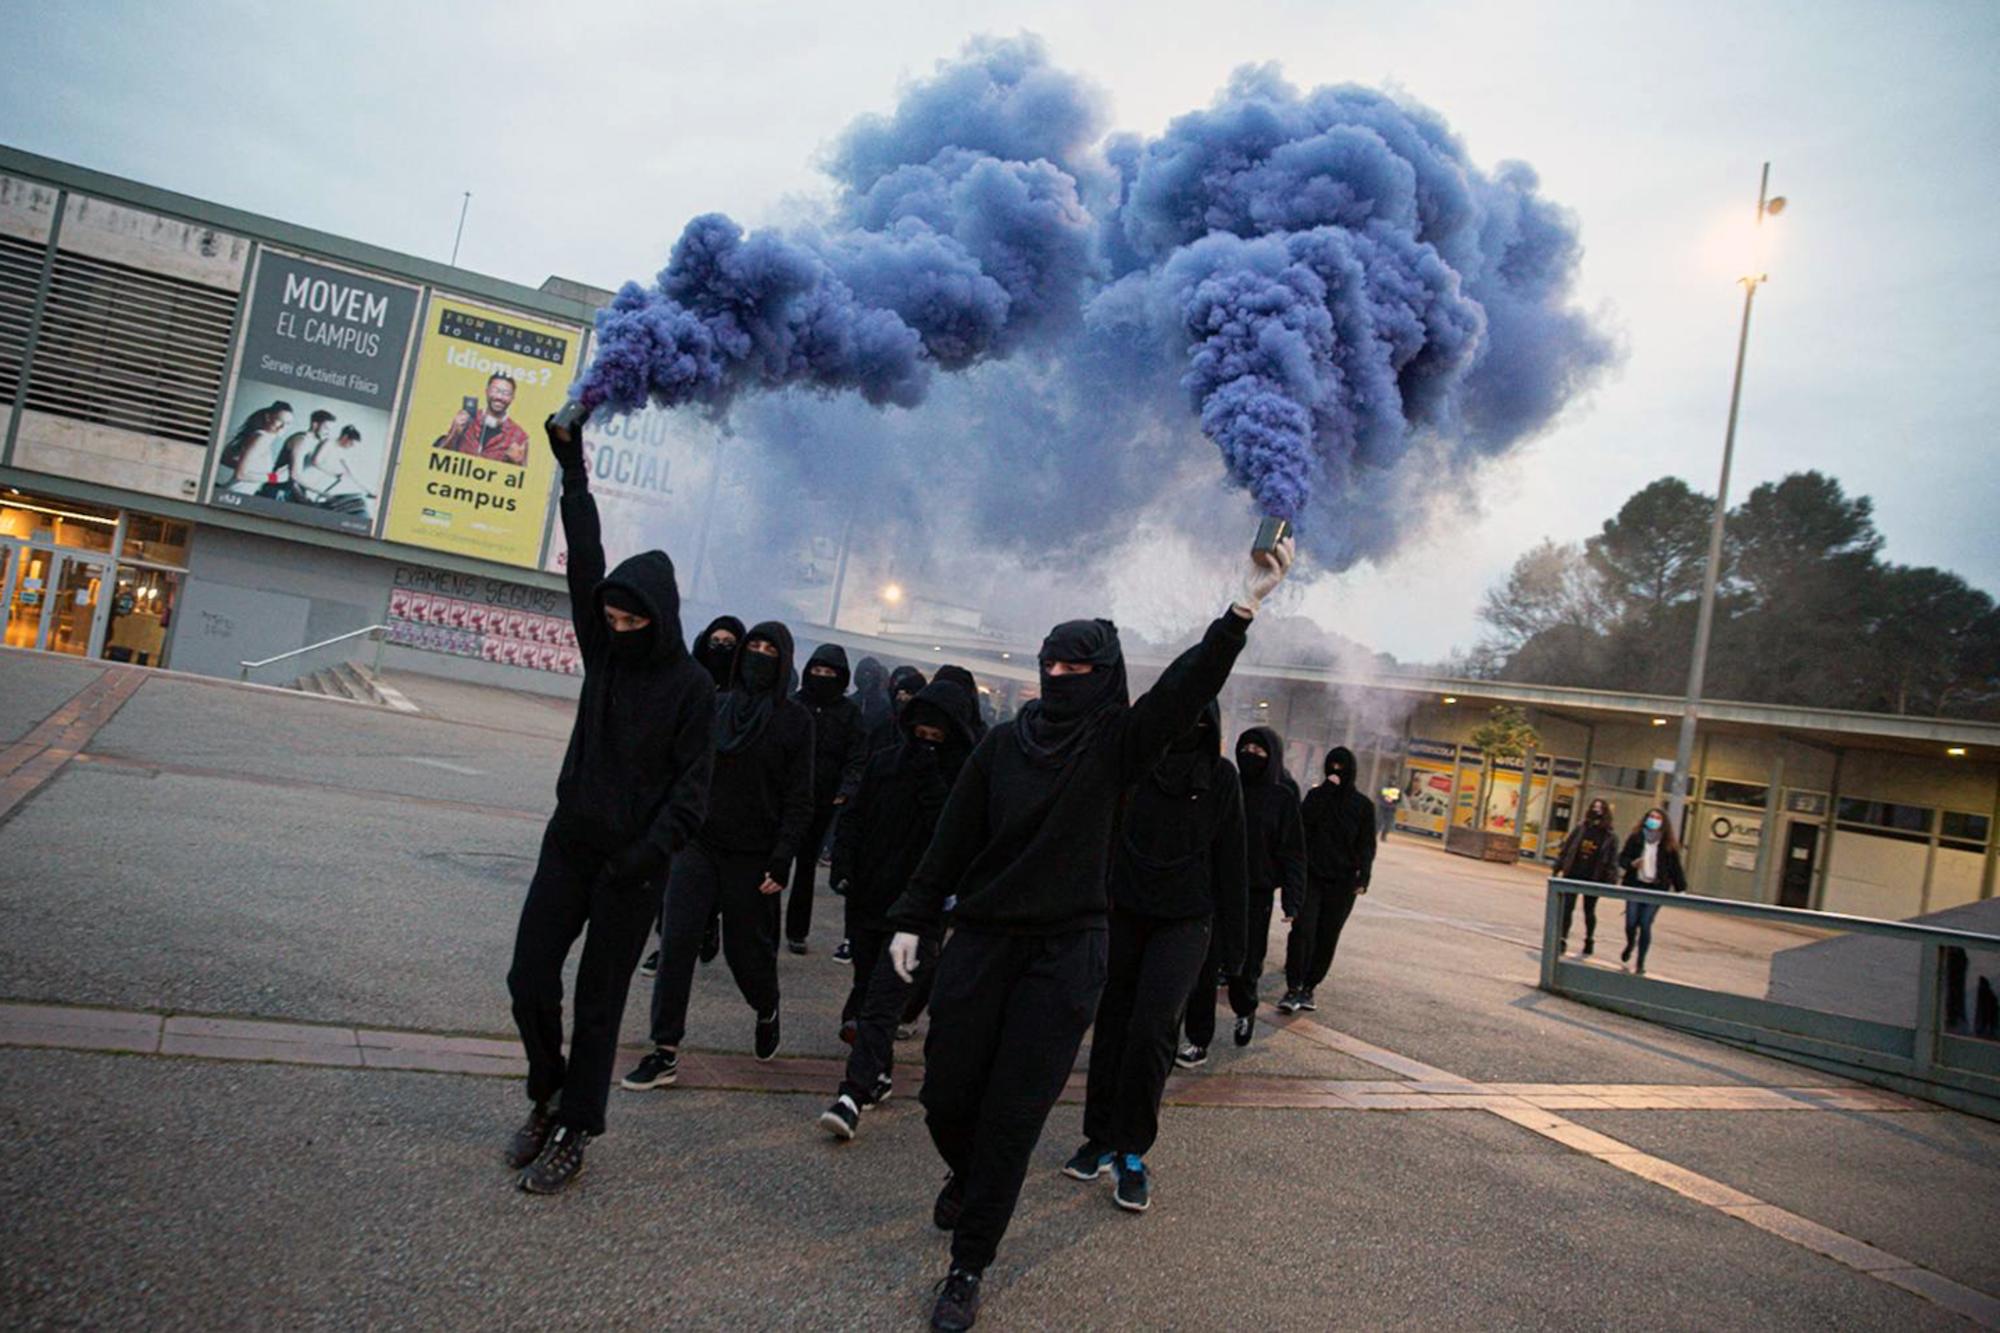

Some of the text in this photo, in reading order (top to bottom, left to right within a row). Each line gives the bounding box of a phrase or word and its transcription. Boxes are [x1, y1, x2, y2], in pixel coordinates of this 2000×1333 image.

[283, 273, 388, 327] MOVEM
[276, 311, 380, 357] EL CAMPUS
[443, 325, 462, 337] TO
[447, 346, 552, 387] Idiomes?
[428, 452, 525, 490] Millor al
[426, 481, 517, 512] campus
